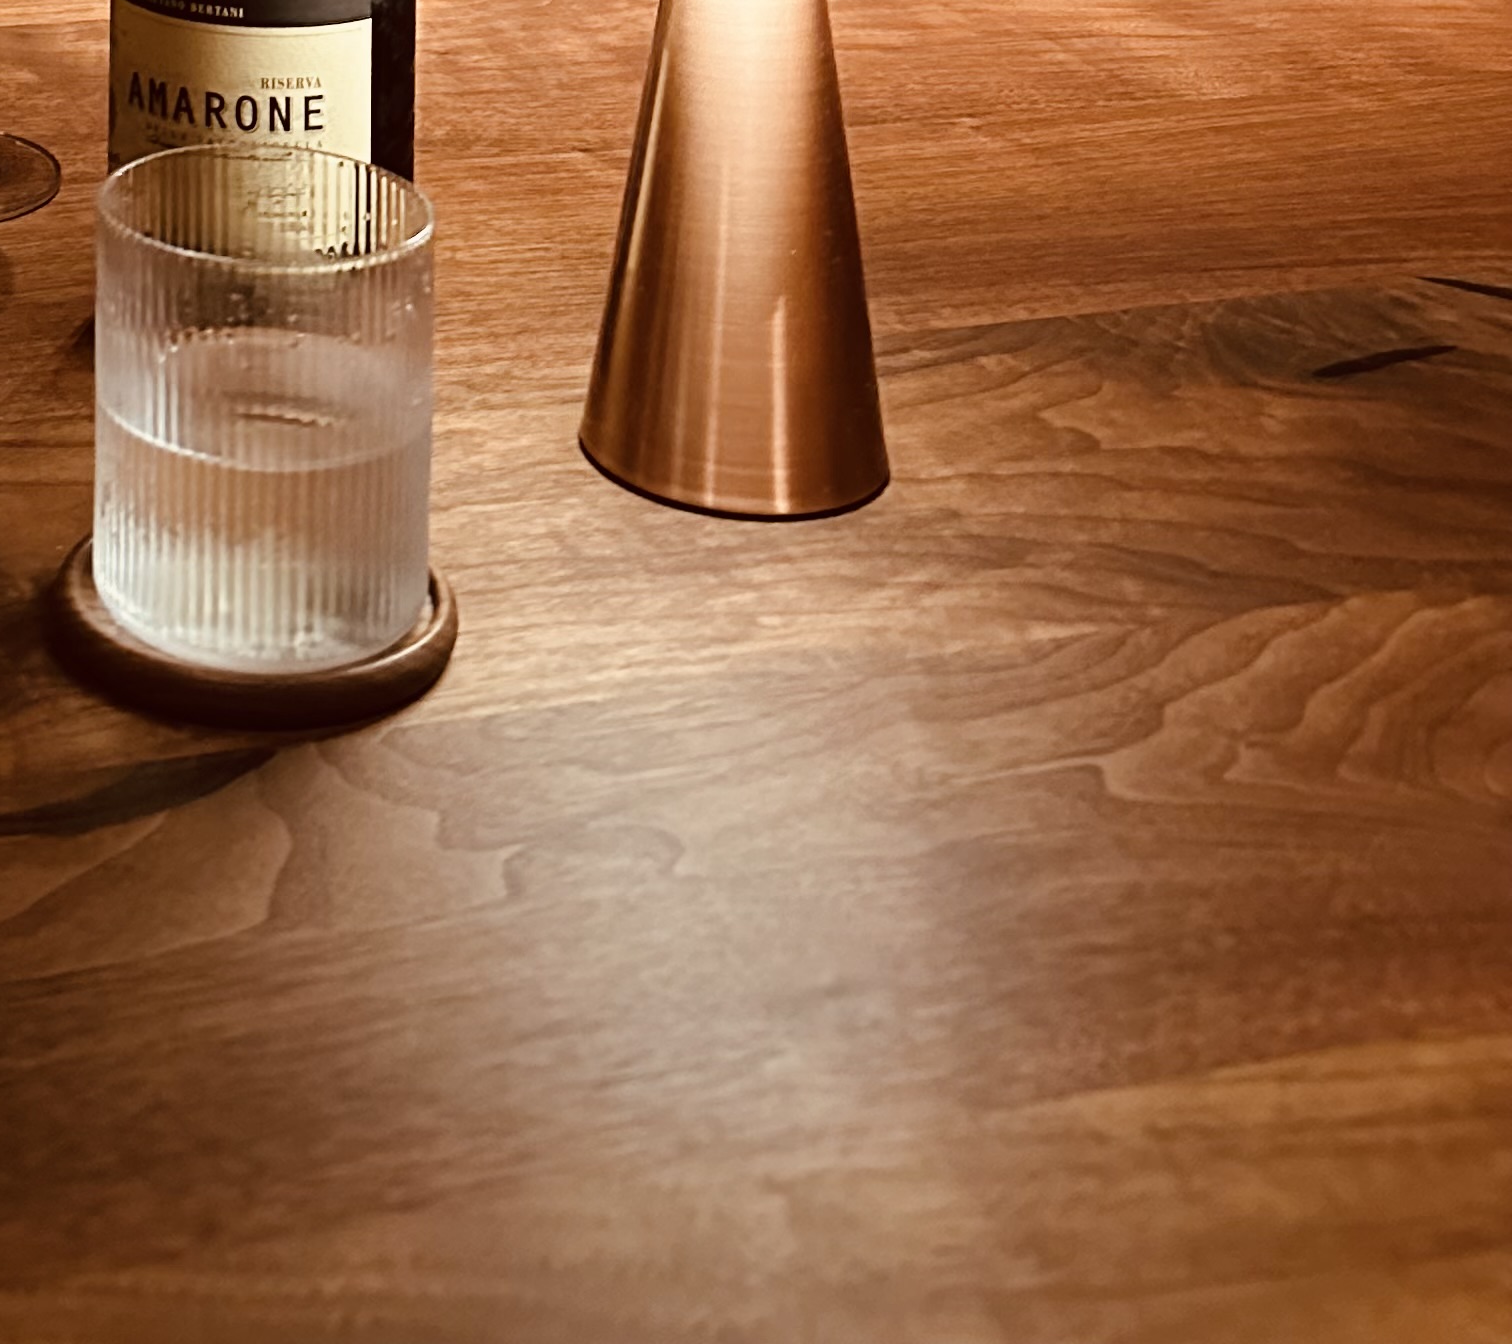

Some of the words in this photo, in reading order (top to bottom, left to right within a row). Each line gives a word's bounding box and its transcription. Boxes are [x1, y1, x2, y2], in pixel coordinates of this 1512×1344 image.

[190, 2, 245, 19] BERTANI
[261, 77, 322, 90] RISERVA
[129, 72, 324, 132] AMARONE
